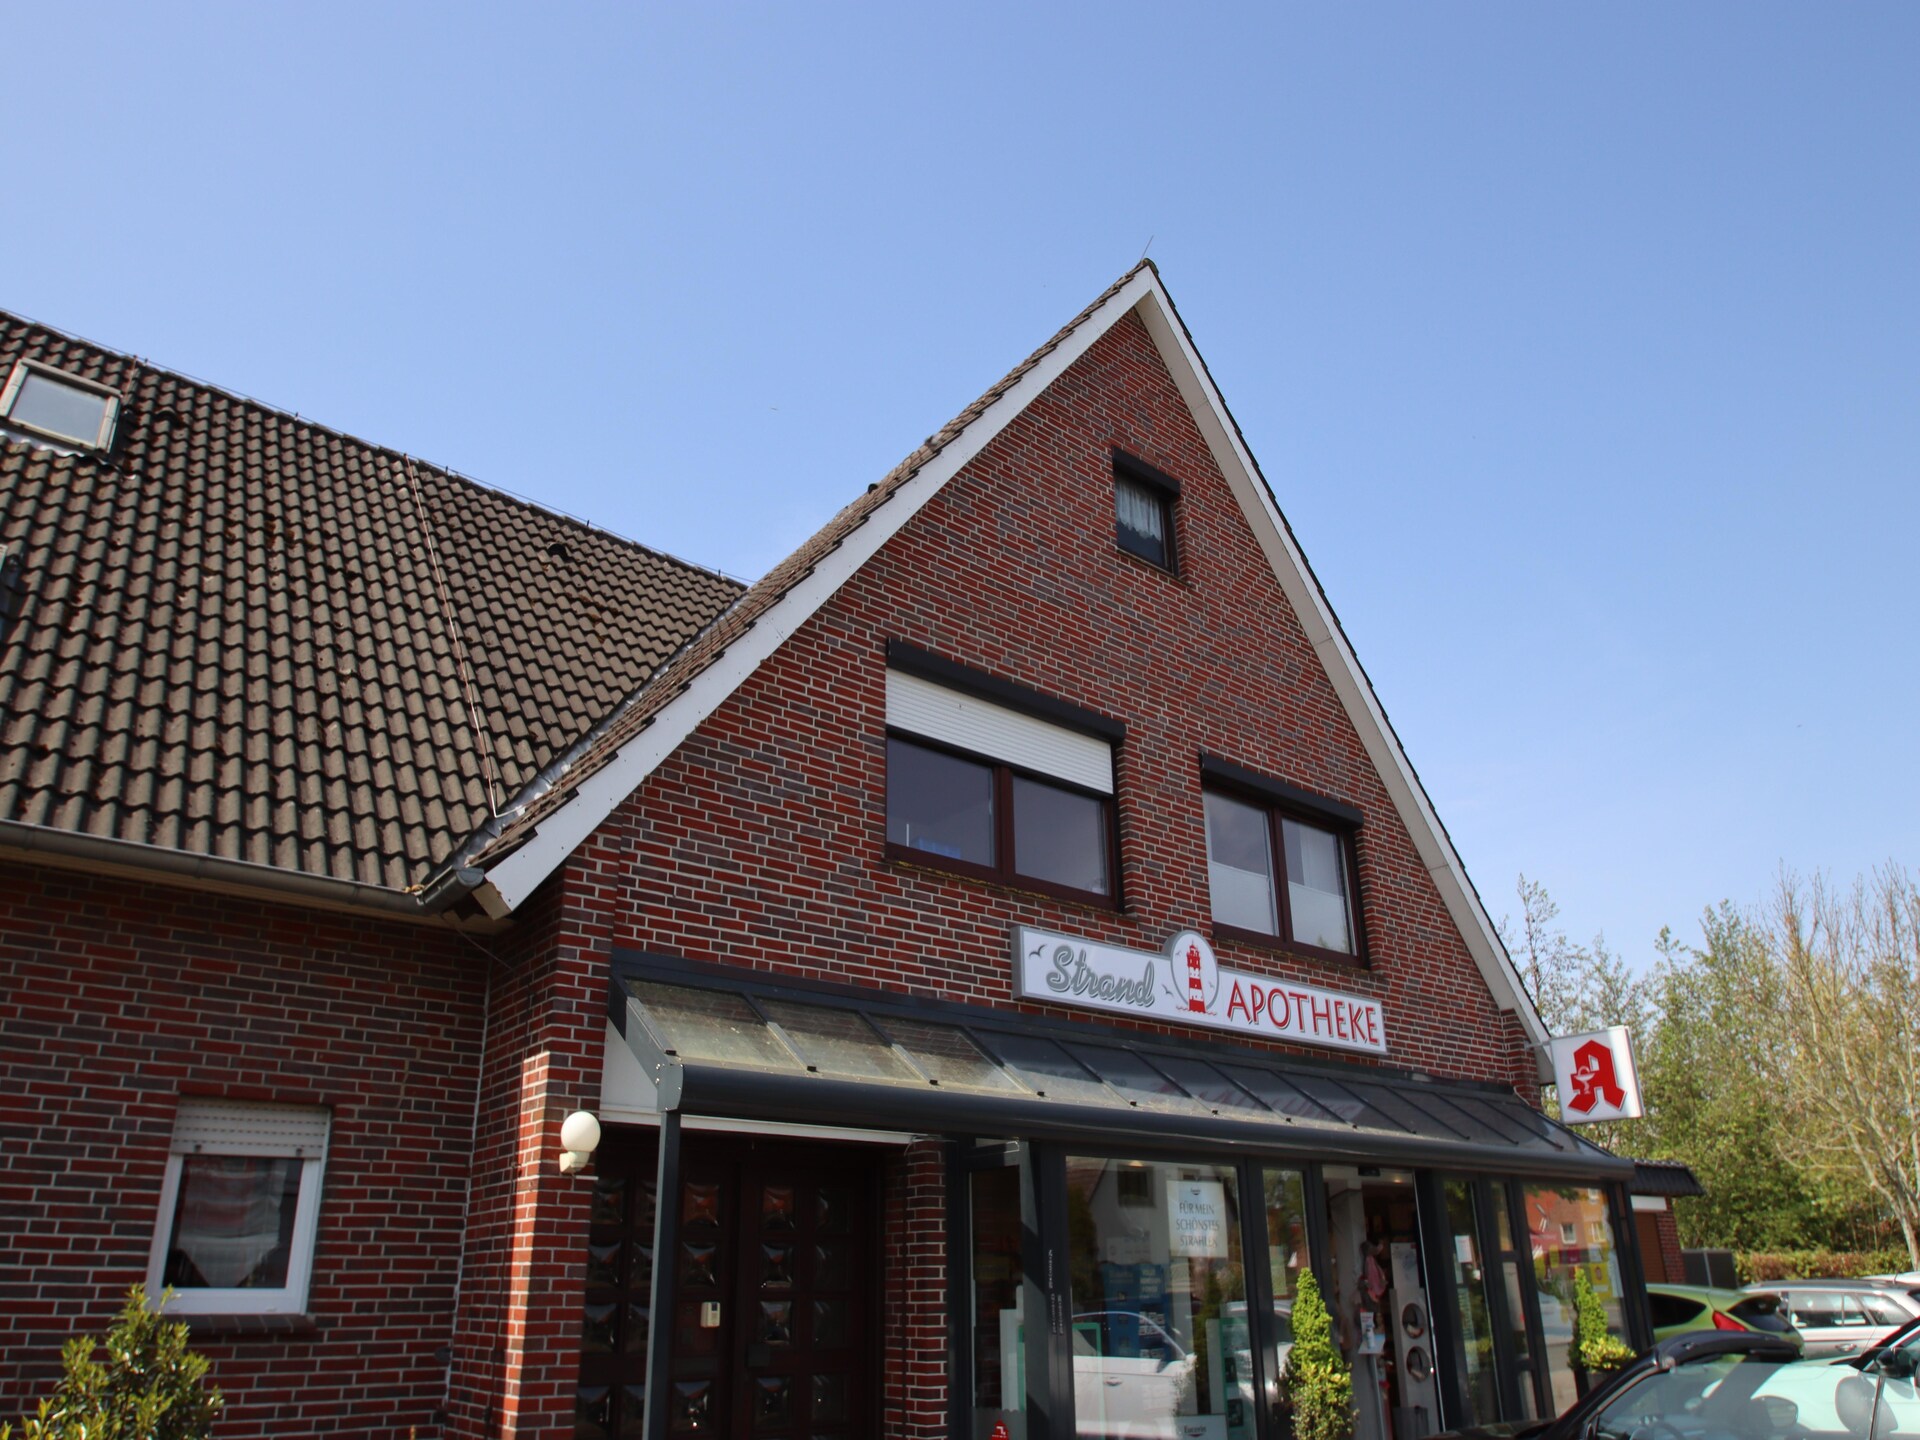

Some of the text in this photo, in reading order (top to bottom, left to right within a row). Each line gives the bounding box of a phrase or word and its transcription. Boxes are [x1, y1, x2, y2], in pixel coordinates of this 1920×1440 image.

[1045, 944, 1380, 1045] Strand APOTHEKE
[1568, 1039, 1628, 1114] A
[1176, 1217, 1220, 1231] SCHÖNSTES
[1179, 1200, 1215, 1215] FÜR MEIN
